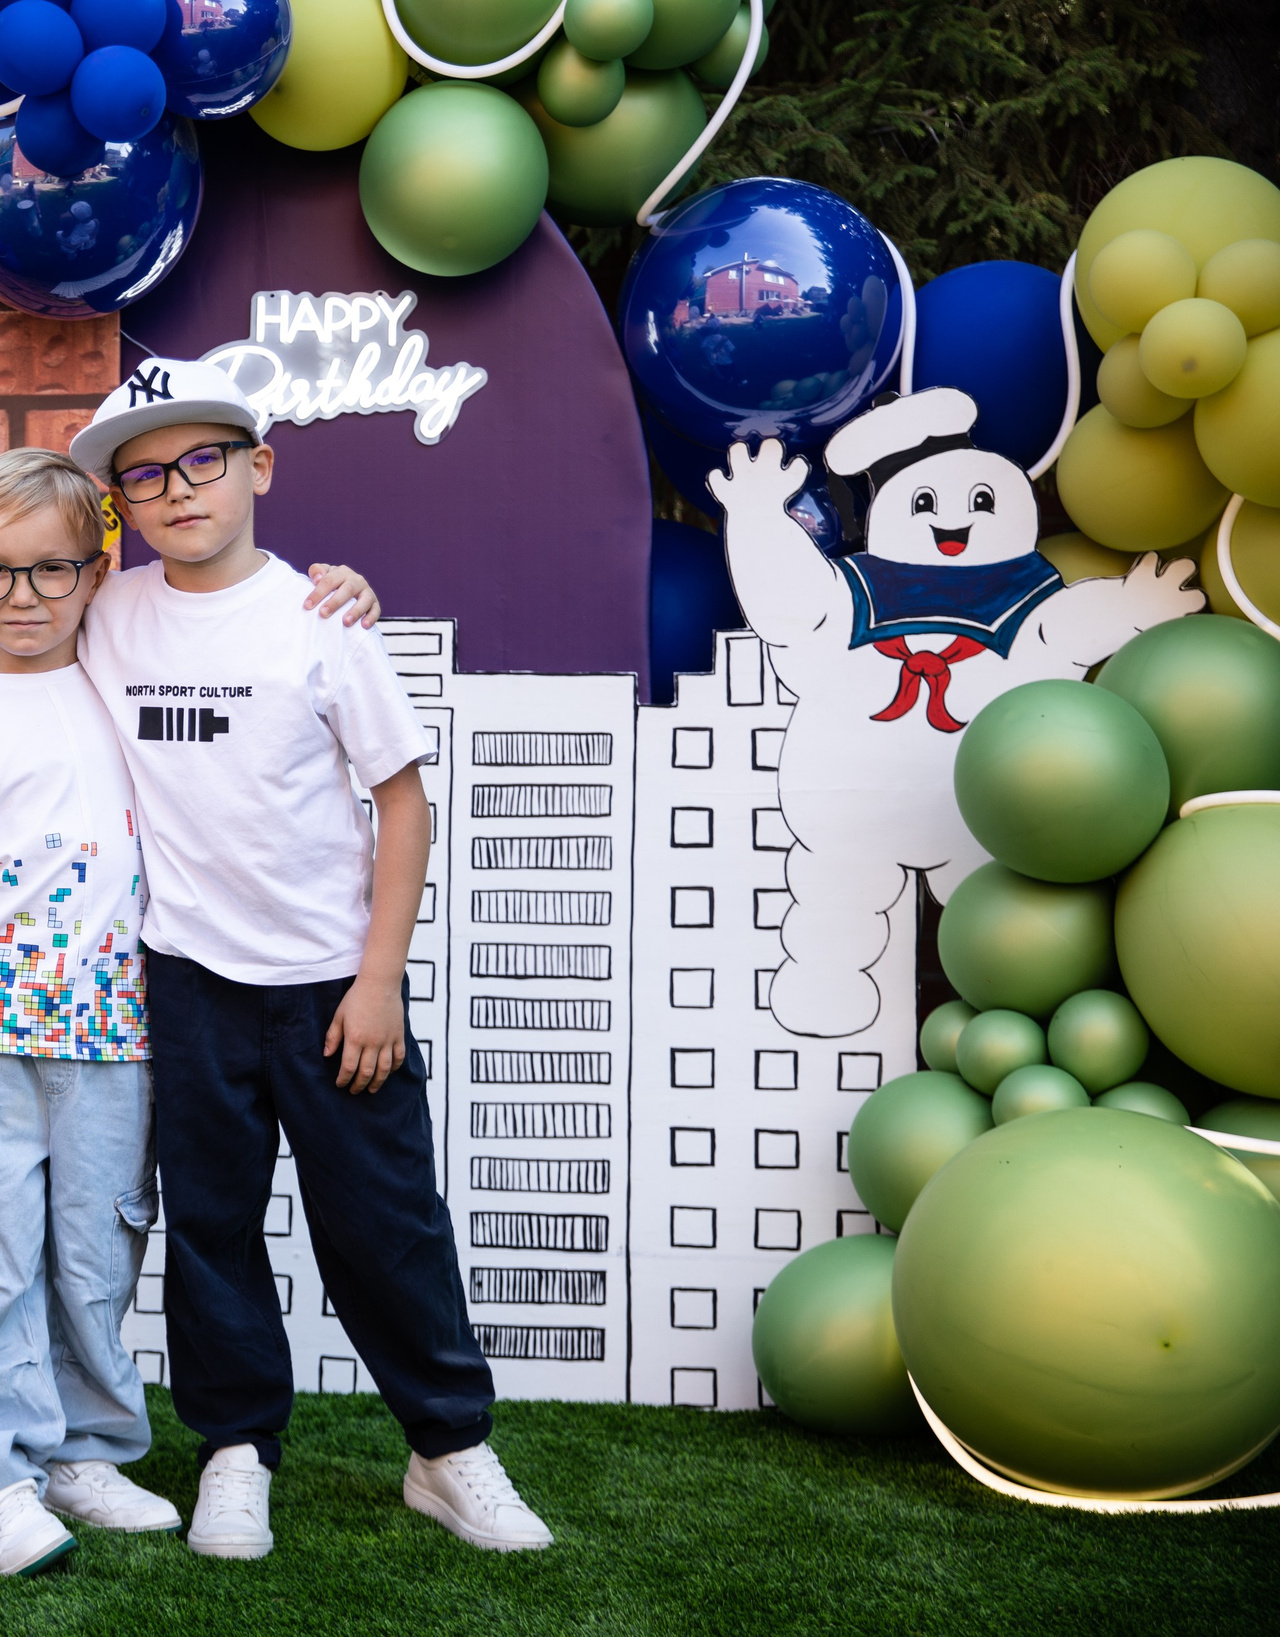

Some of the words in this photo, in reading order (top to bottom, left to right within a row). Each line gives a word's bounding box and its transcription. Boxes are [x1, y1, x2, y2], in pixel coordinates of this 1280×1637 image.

[256, 294, 412, 346] HAPPY
[127, 366, 175, 408] NY
[204, 334, 483, 438] Birthday
[126, 685, 156, 697] NORTH
[158, 685, 196, 697] SPORT
[199, 686, 253, 697] CULTURE
